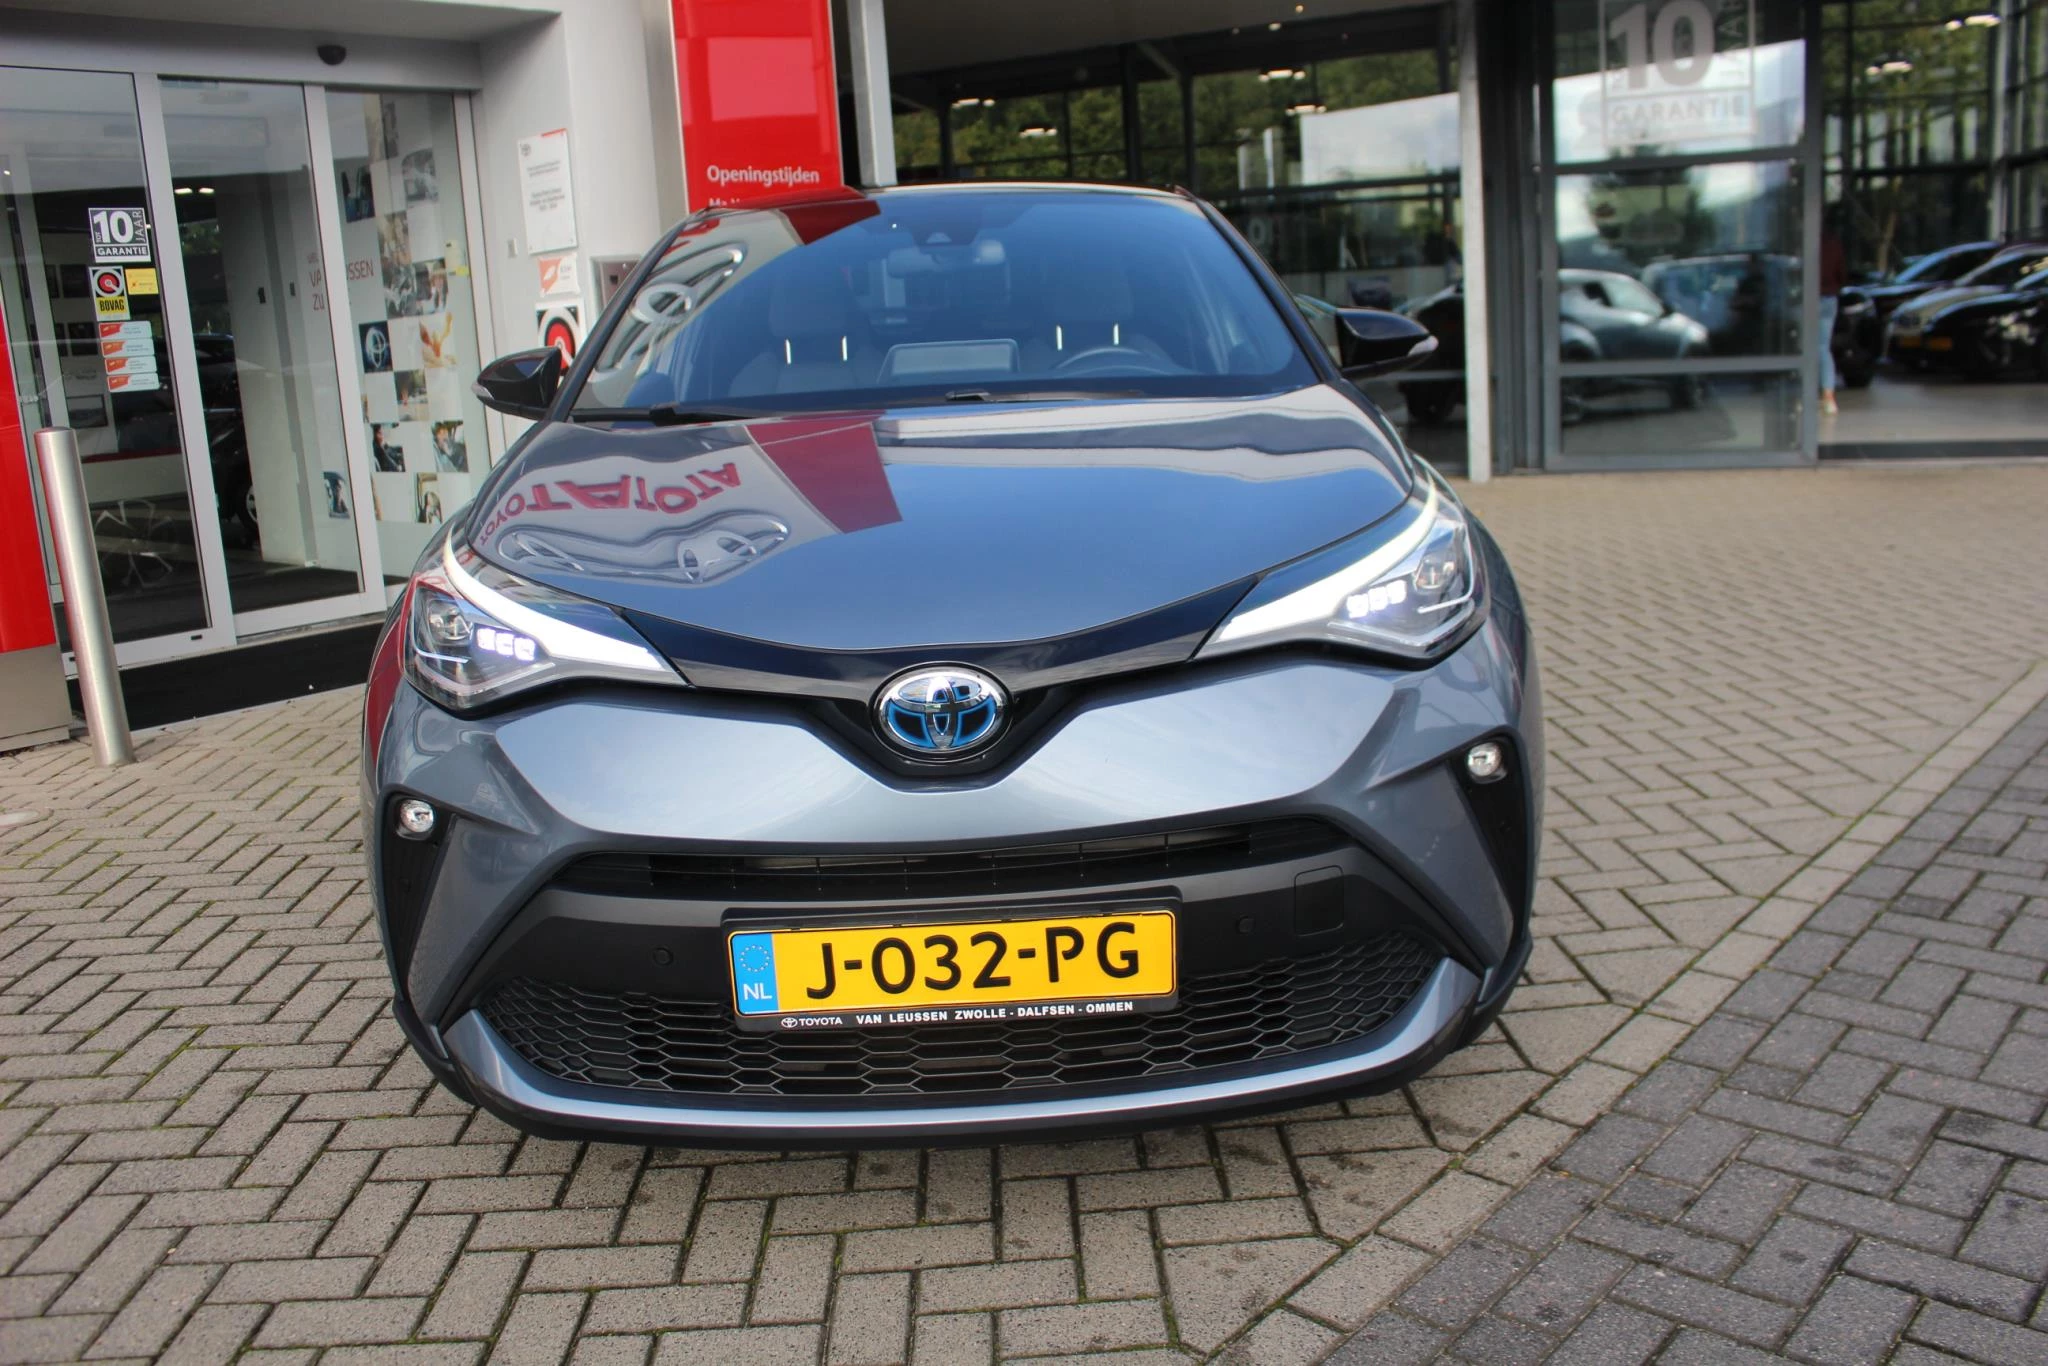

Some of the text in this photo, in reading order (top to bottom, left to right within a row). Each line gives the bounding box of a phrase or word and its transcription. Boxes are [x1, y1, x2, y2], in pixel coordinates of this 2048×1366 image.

[1609, 0, 1715, 87] 10
[707, 165, 819, 187] Openingstijden
[93, 210, 134, 243] 10
[132, 211, 146, 243] JAAR
[97, 246, 147, 255] GARANTIE
[100, 299, 125, 312] BOVAG
[806, 921, 1139, 1000] J-032-PG
[743, 983, 772, 1000] NL
[799, 1016, 843, 1026] TOYOTA
[856, 1014, 882, 1024] VAN
[889, 1011, 948, 1022] LEUSSEN
[955, 1008, 1006, 1020] ZWOLLE
[1018, 1004, 1075, 1016] DALFSEN
[1086, 1001, 1133, 1013] OMMEN
